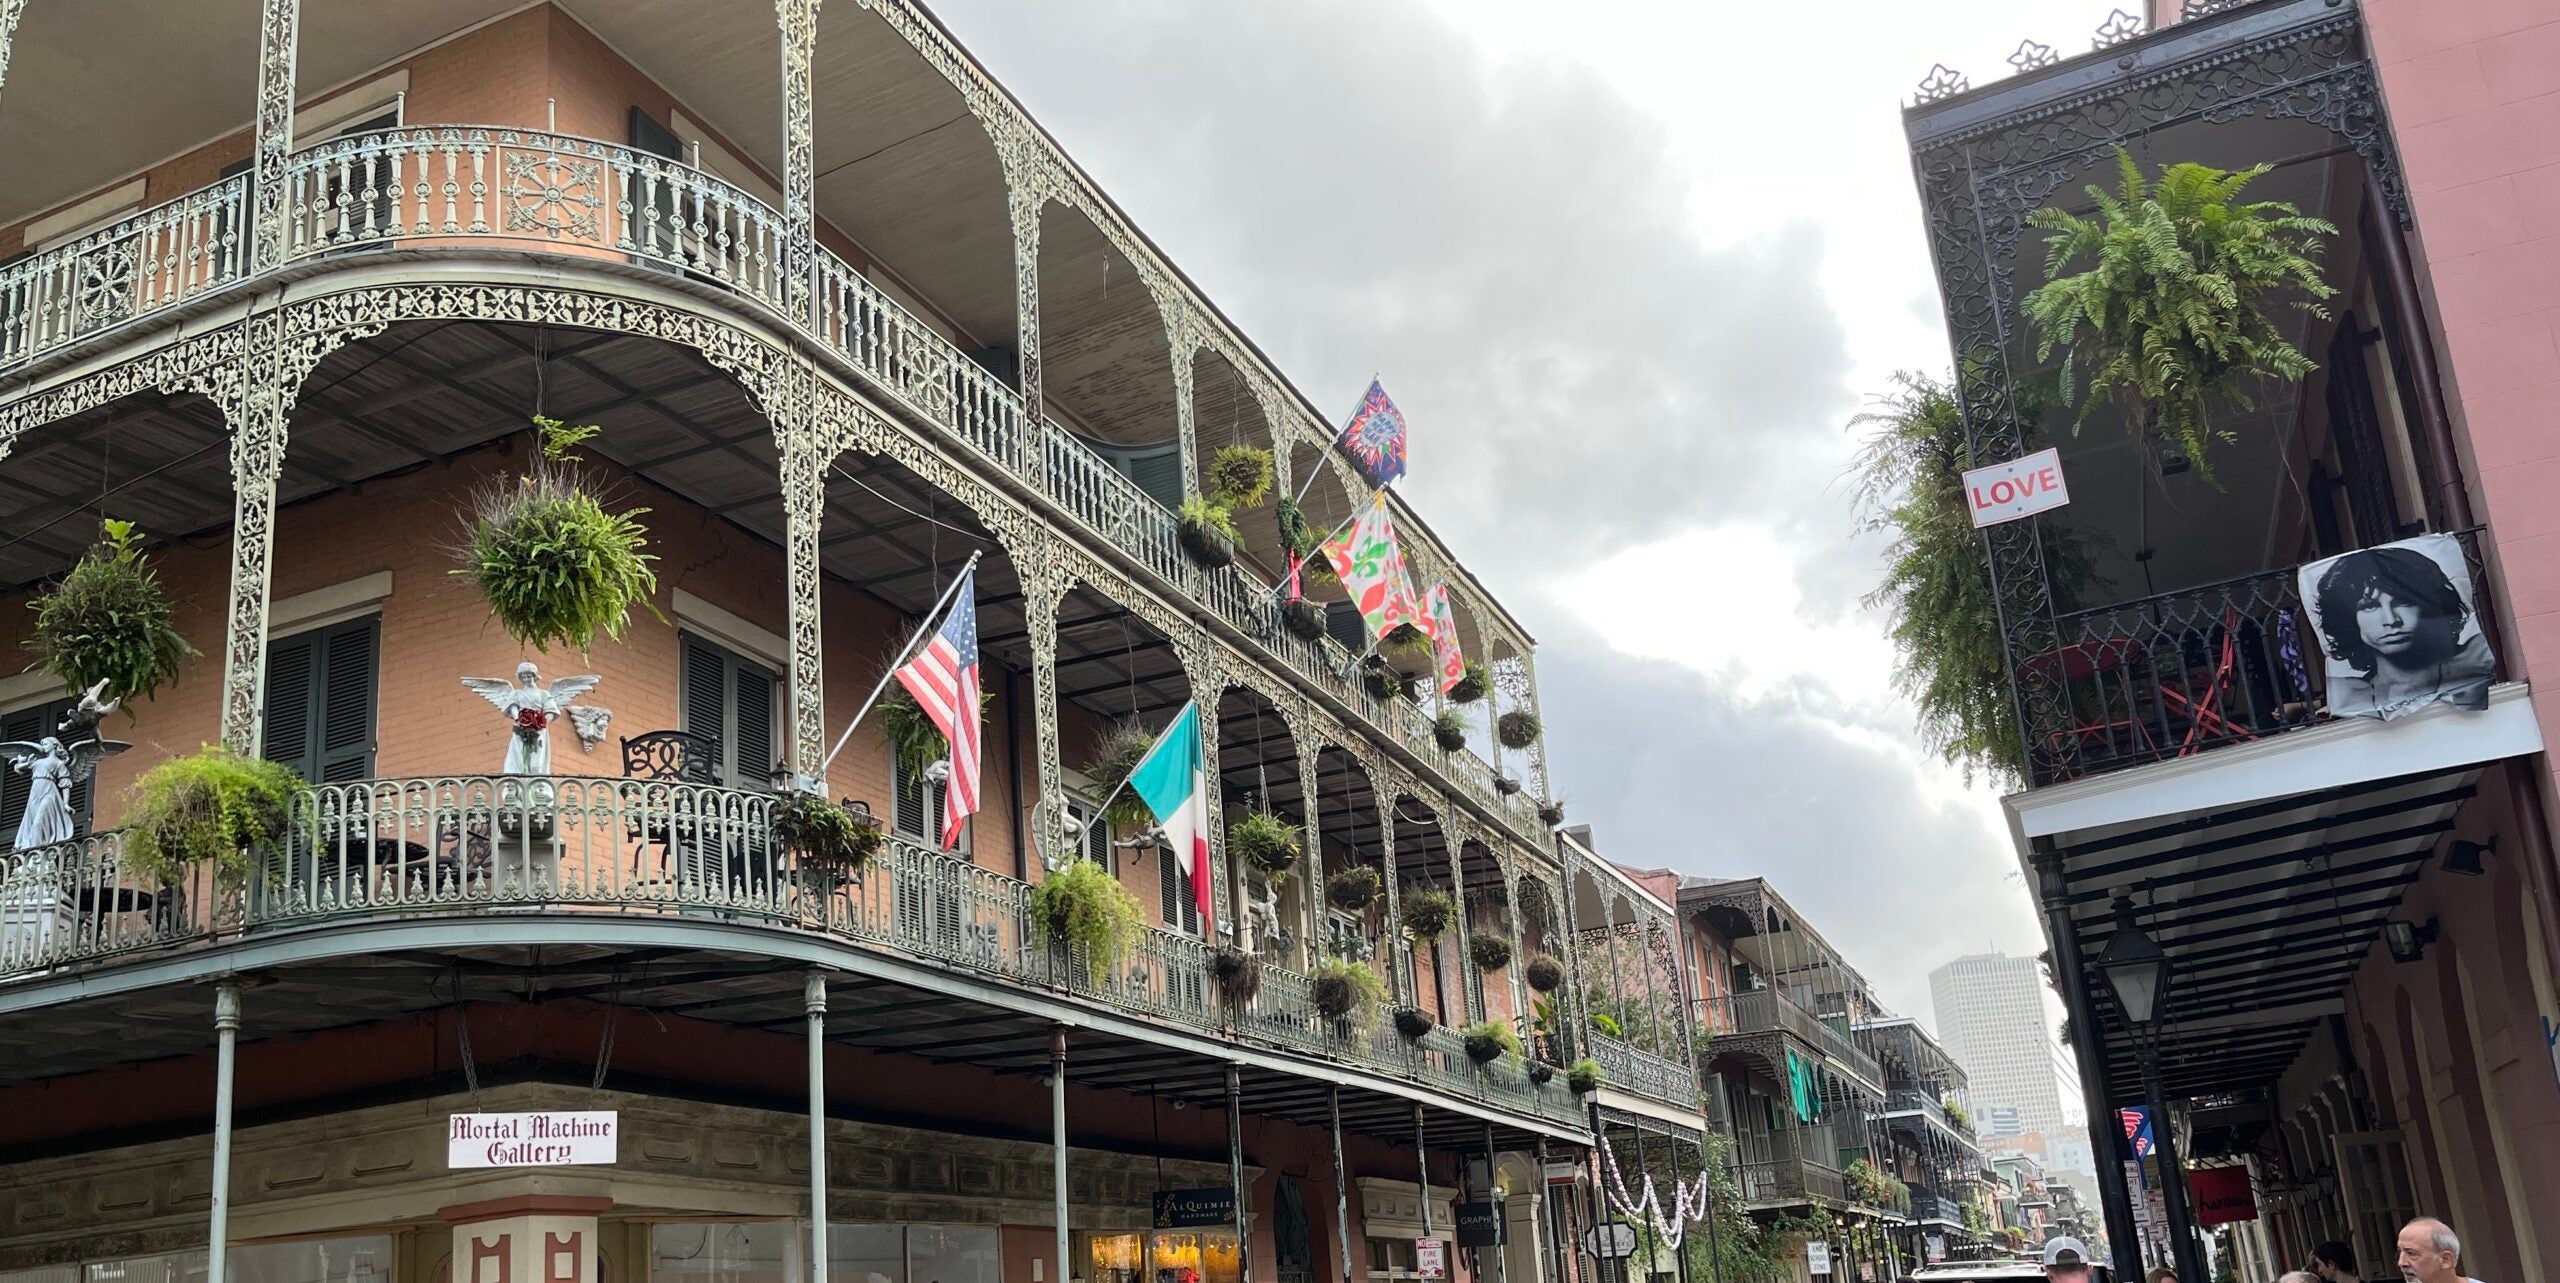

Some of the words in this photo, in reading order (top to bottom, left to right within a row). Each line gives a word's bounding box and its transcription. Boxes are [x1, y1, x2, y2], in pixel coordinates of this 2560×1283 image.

[1972, 467, 2058, 509] LOVE
[451, 1115, 519, 1143] Mortal
[528, 1114, 611, 1141] Machine
[487, 1142, 572, 1165] Gallery
[1417, 1239, 1426, 1248] NO
